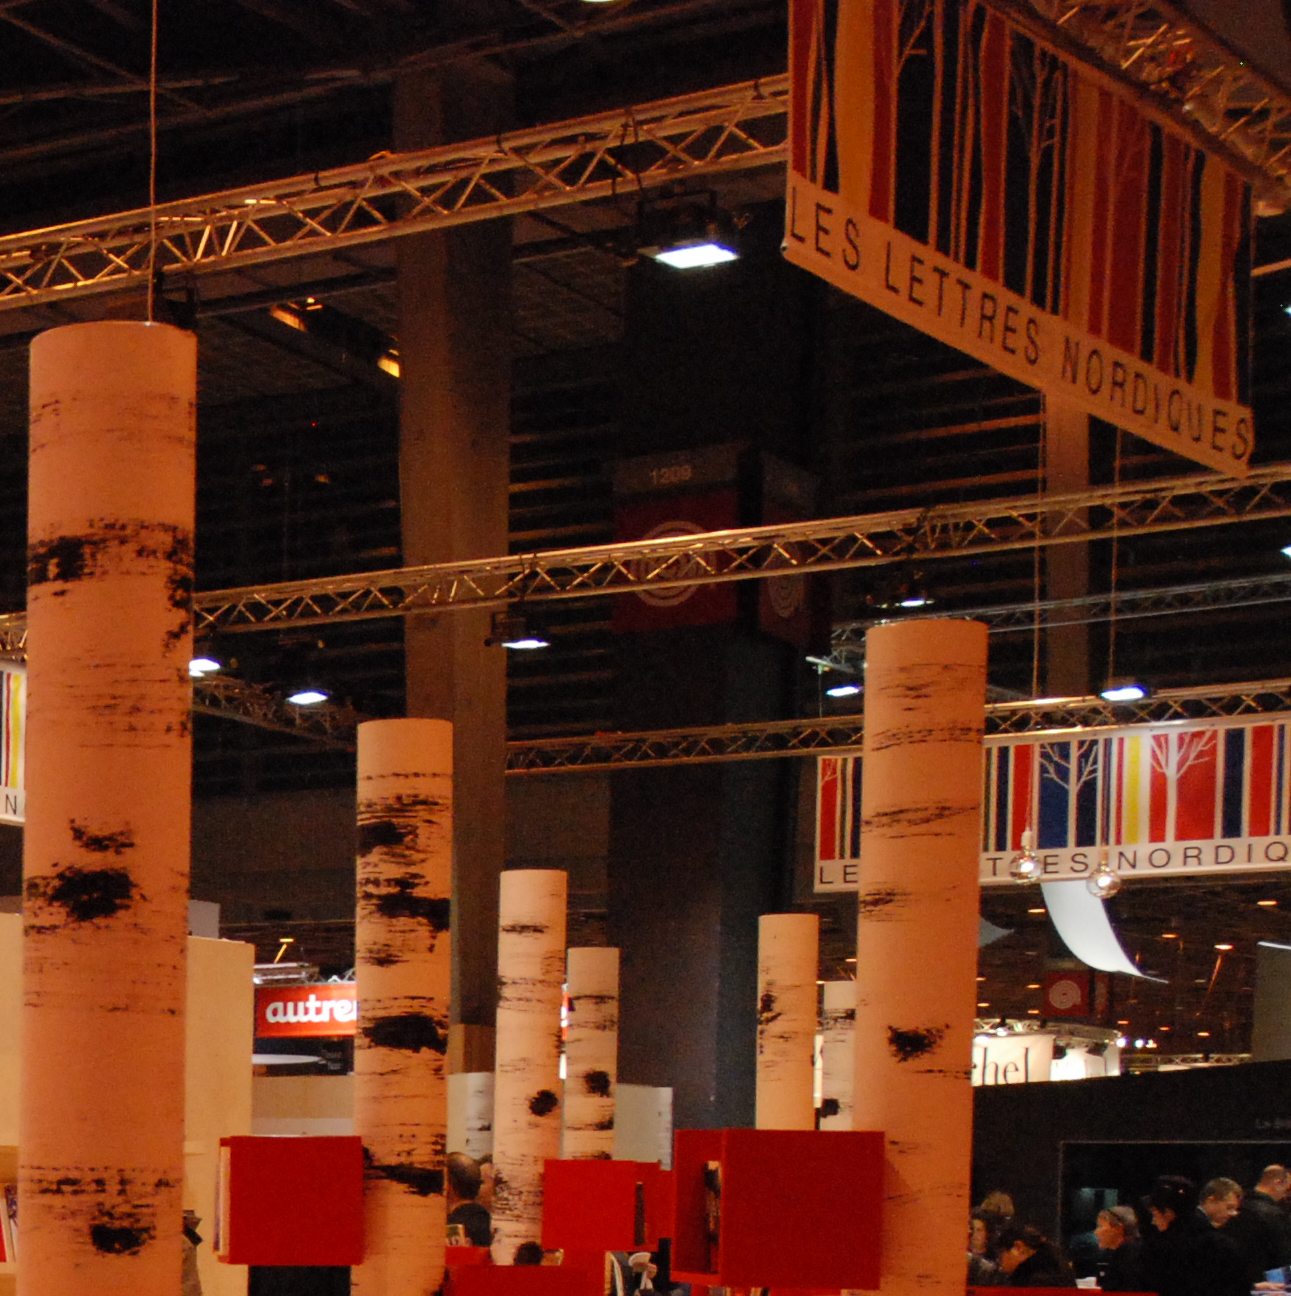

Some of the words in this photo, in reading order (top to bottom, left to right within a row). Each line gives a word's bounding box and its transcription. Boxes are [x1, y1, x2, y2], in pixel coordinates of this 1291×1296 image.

[789, 185, 860, 271] LES
[885, 239, 1041, 366] LETTRES
[1061, 335, 1251, 462] NORDIQUES
[820, 863, 858, 884] LE
[265, 994, 357, 1024] autre
